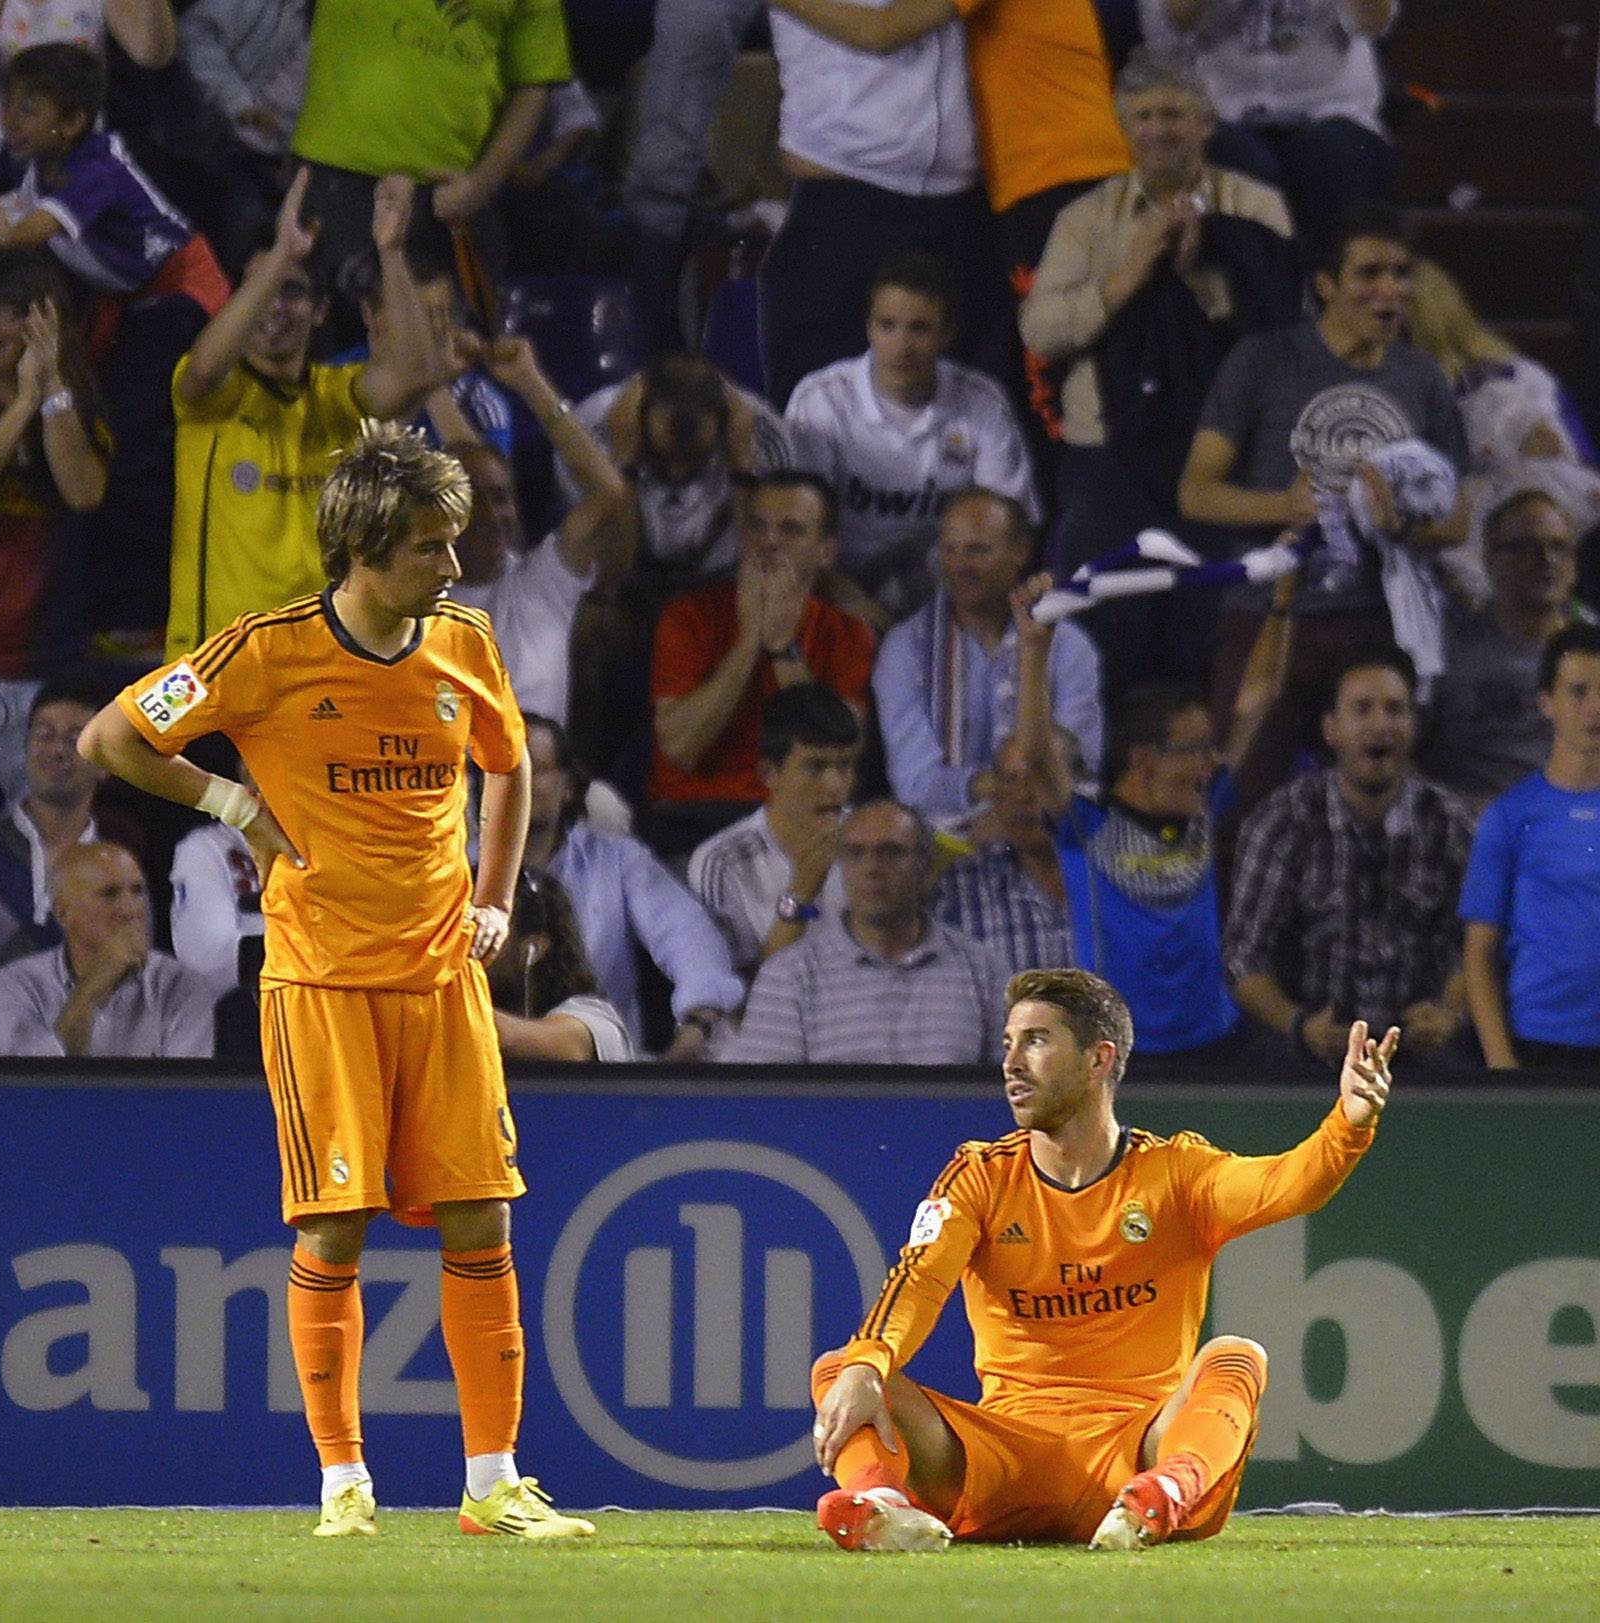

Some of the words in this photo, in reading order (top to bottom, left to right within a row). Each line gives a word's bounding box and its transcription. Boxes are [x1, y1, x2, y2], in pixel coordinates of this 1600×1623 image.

[140, 693, 171, 722] LFP
[378, 734, 419, 760] Fly
[325, 759, 458, 794] Emirates
[1058, 1262, 1102, 1285] Fly
[1007, 1279, 1157, 1319] Emirates
